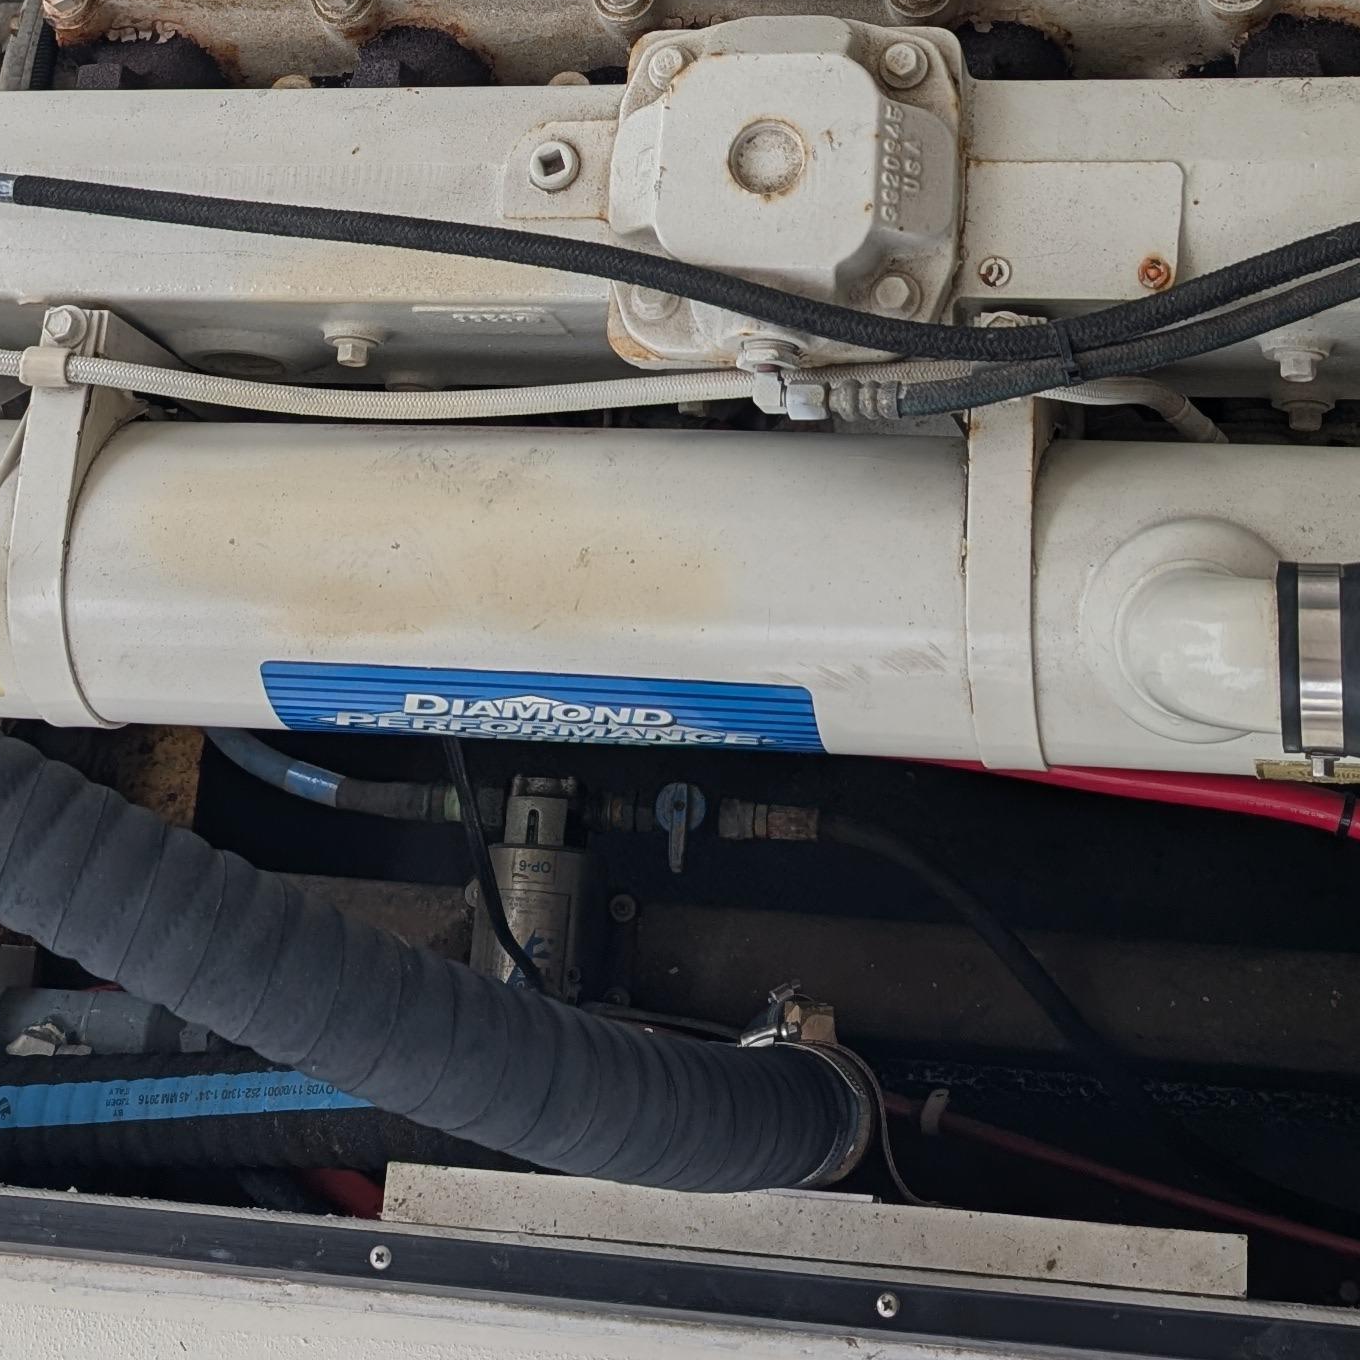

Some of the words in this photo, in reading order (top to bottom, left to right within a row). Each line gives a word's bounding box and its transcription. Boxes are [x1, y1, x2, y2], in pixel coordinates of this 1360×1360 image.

[903, 140, 922, 197] USA
[402, 692, 676, 727] DIAMOND
[336, 710, 763, 746] PERFORMANCE
[307, 1084, 339, 1098] OYDS
